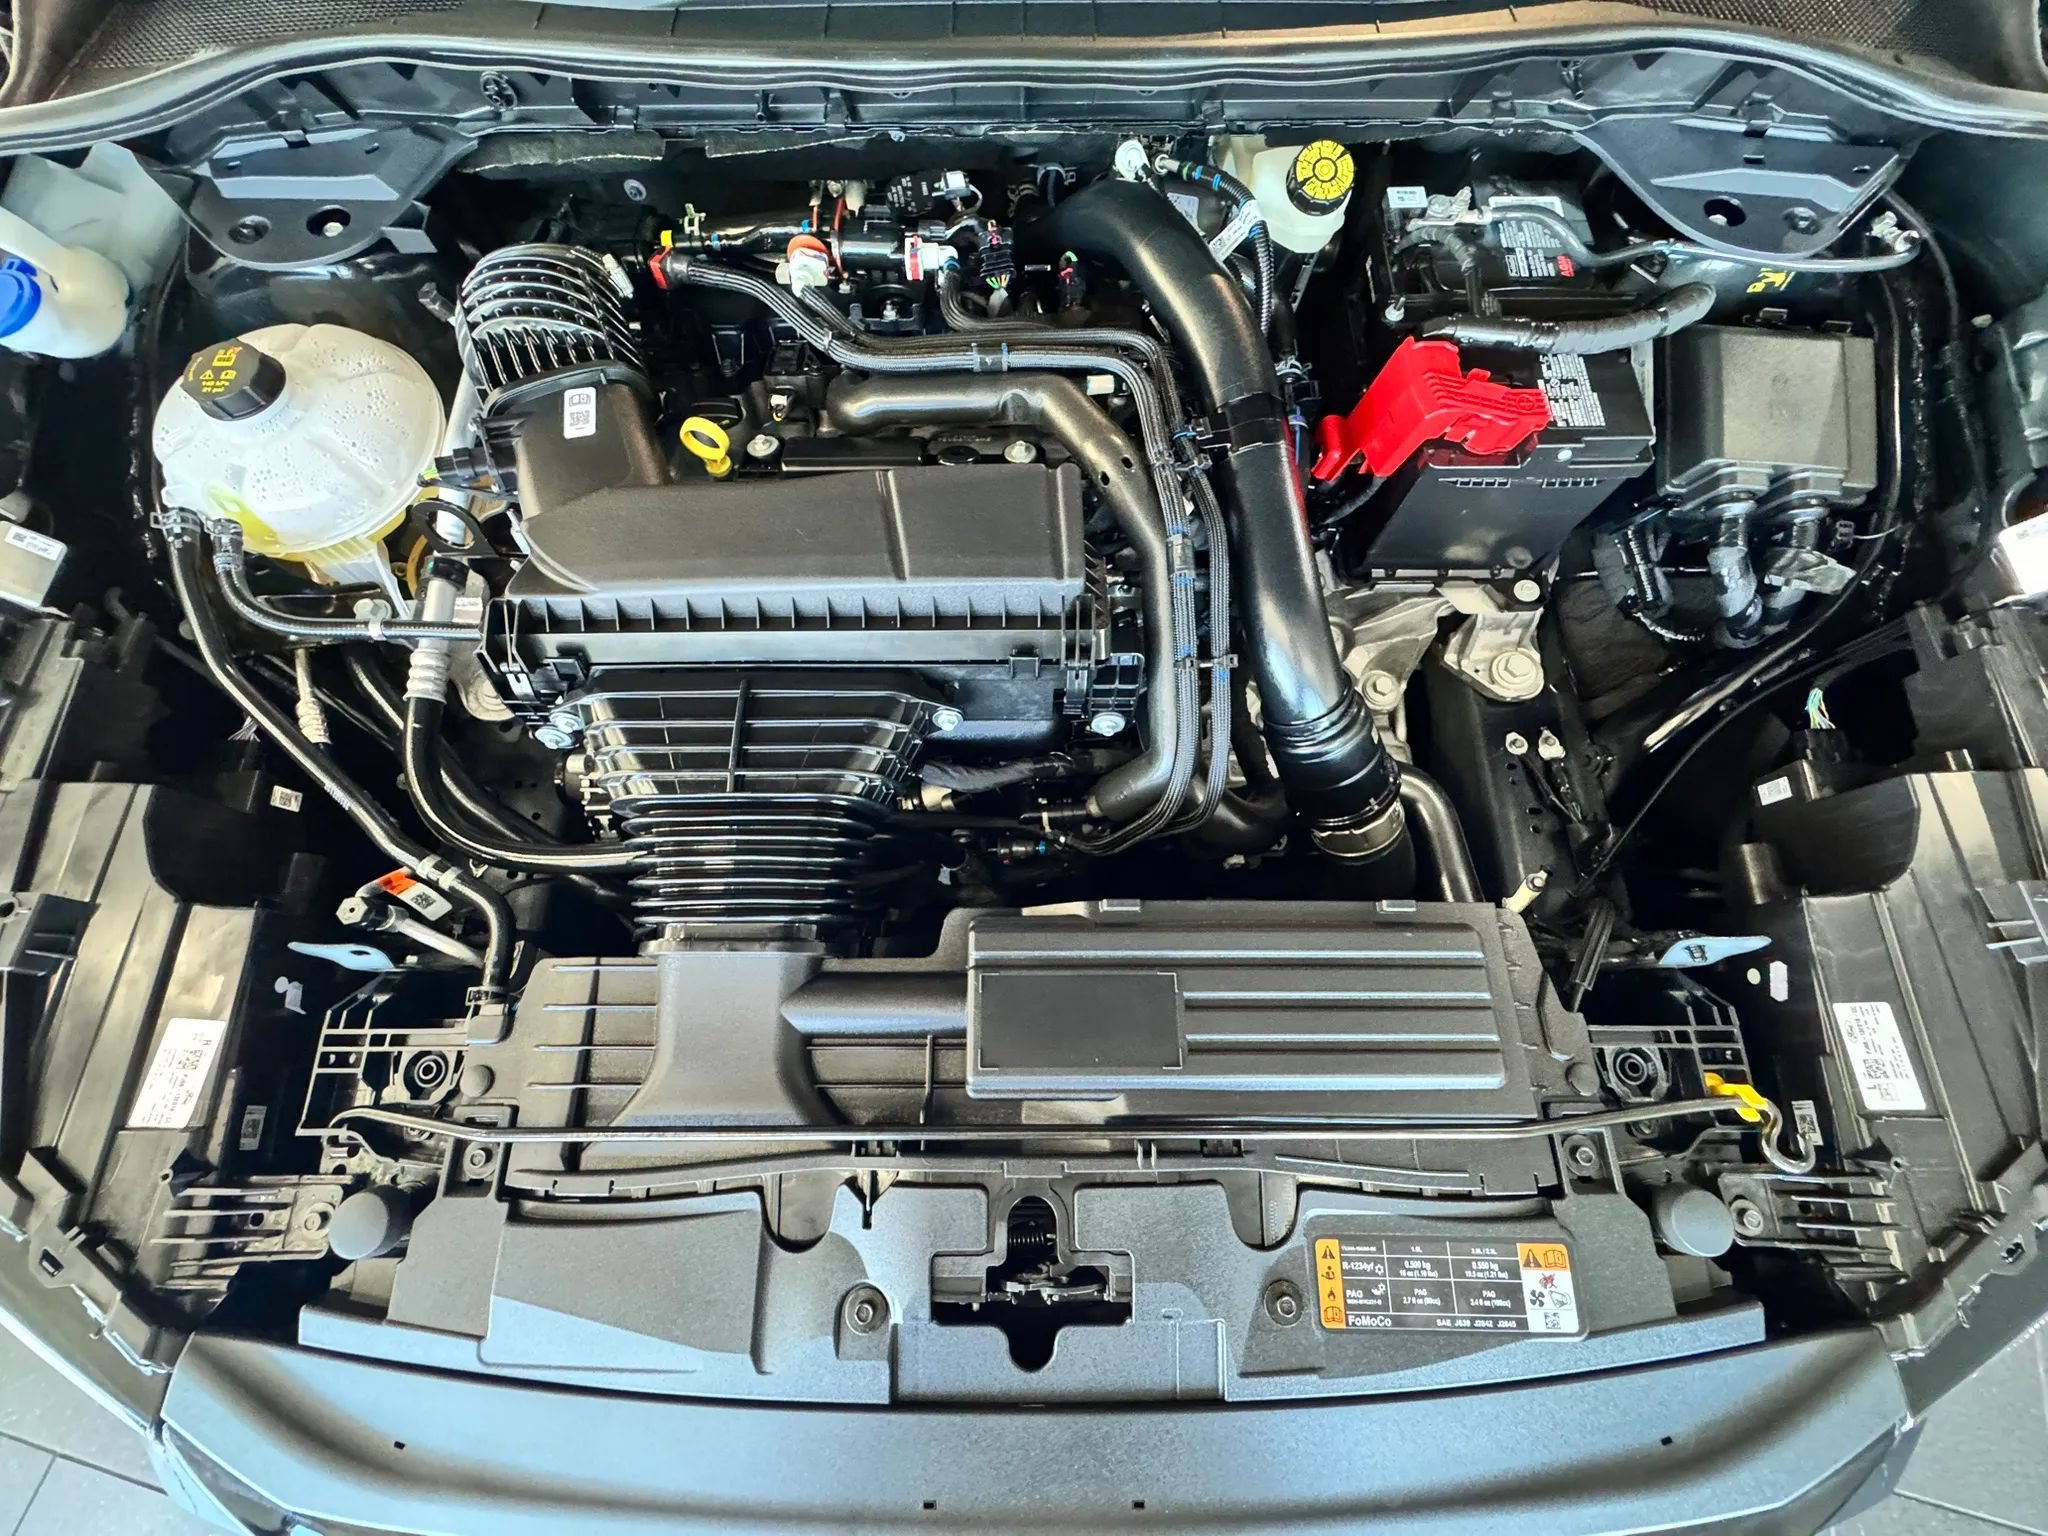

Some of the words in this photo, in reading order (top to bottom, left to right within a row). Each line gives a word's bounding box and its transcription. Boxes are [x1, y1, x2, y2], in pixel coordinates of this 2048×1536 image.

[1342, 1261, 1375, 1272] R-1234yf
[1346, 1289, 1363, 1298] PAG
[1348, 1315, 1392, 1326] FoMoCo
[1436, 1319, 1451, 1327] SAE
